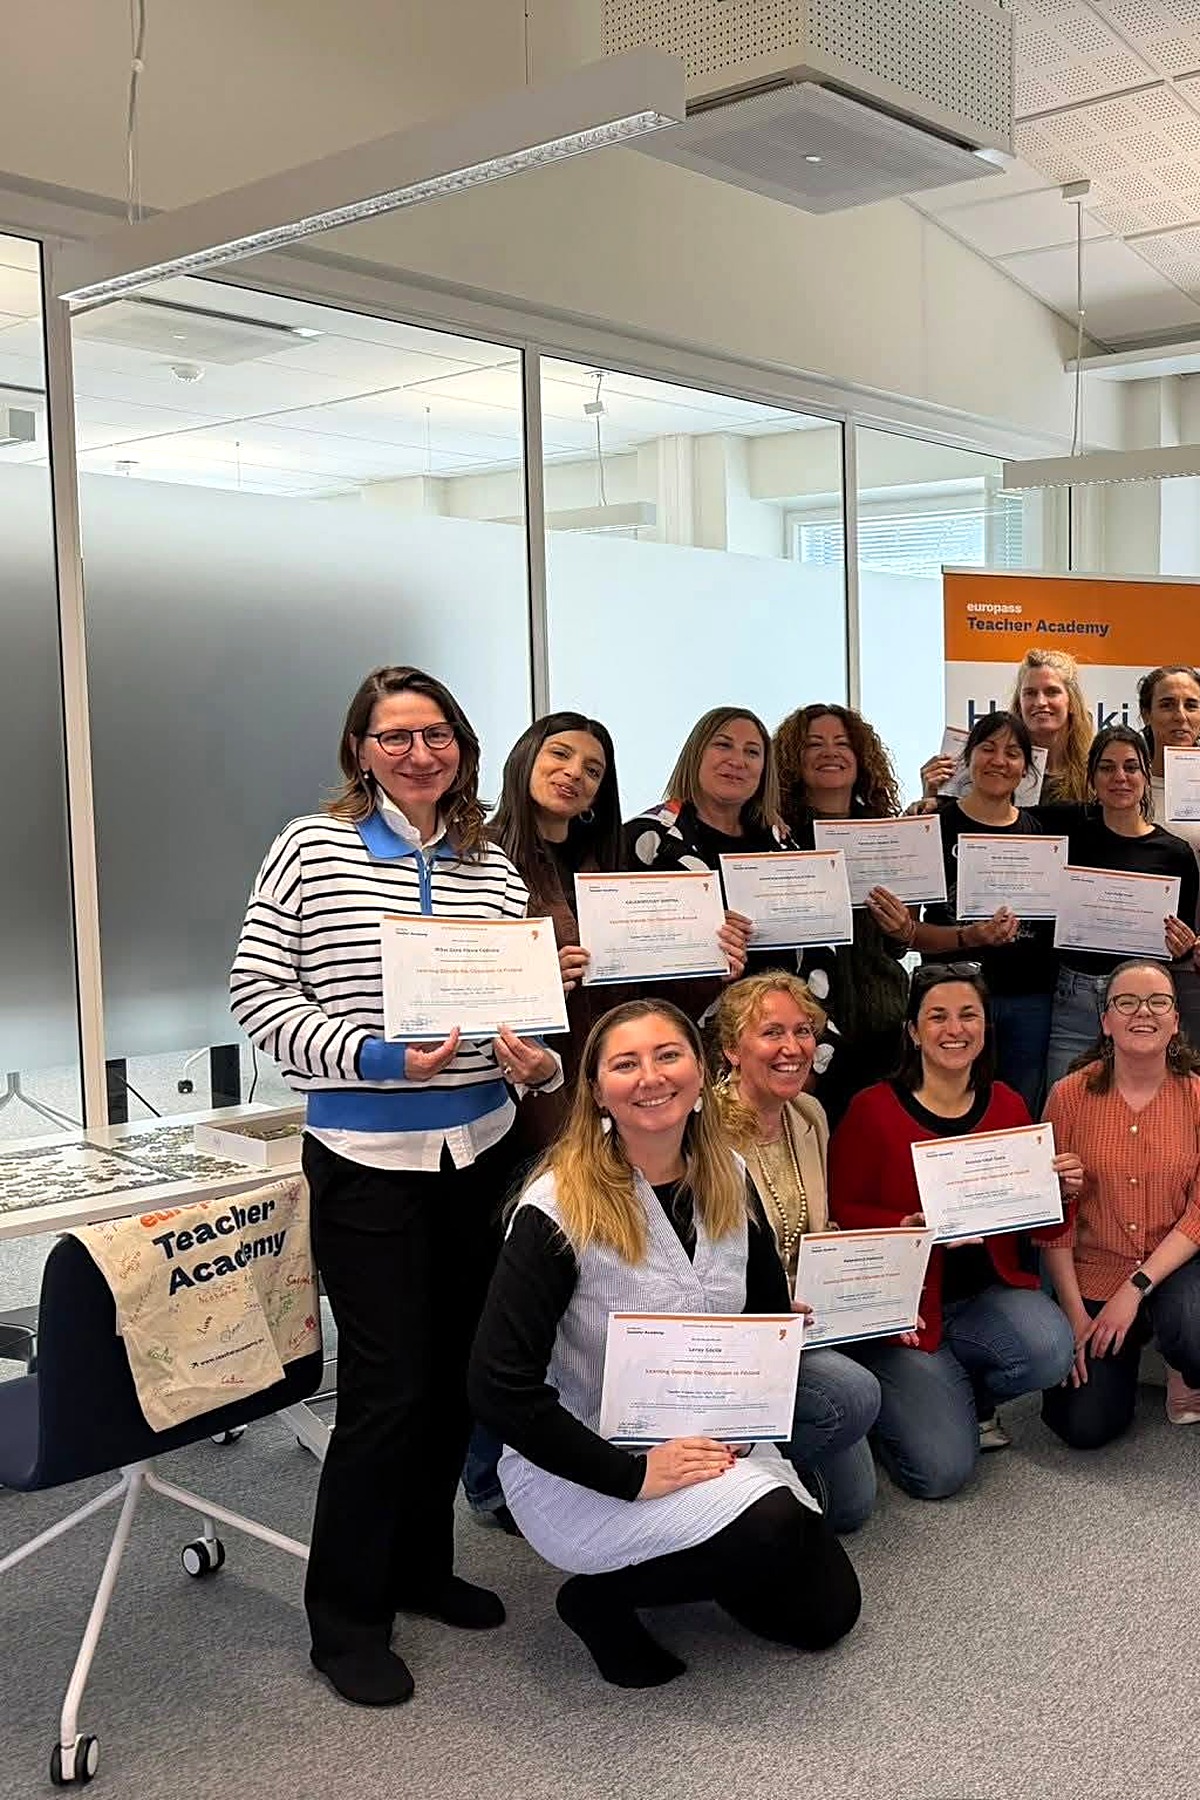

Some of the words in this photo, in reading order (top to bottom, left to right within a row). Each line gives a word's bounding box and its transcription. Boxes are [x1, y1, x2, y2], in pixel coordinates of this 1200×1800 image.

[967, 602, 1022, 615] europass
[967, 616, 1032, 632] Teacher
[1036, 619, 1110, 637] Academy
[152, 1199, 276, 1260] Teacher
[169, 1229, 287, 1297] Academy
